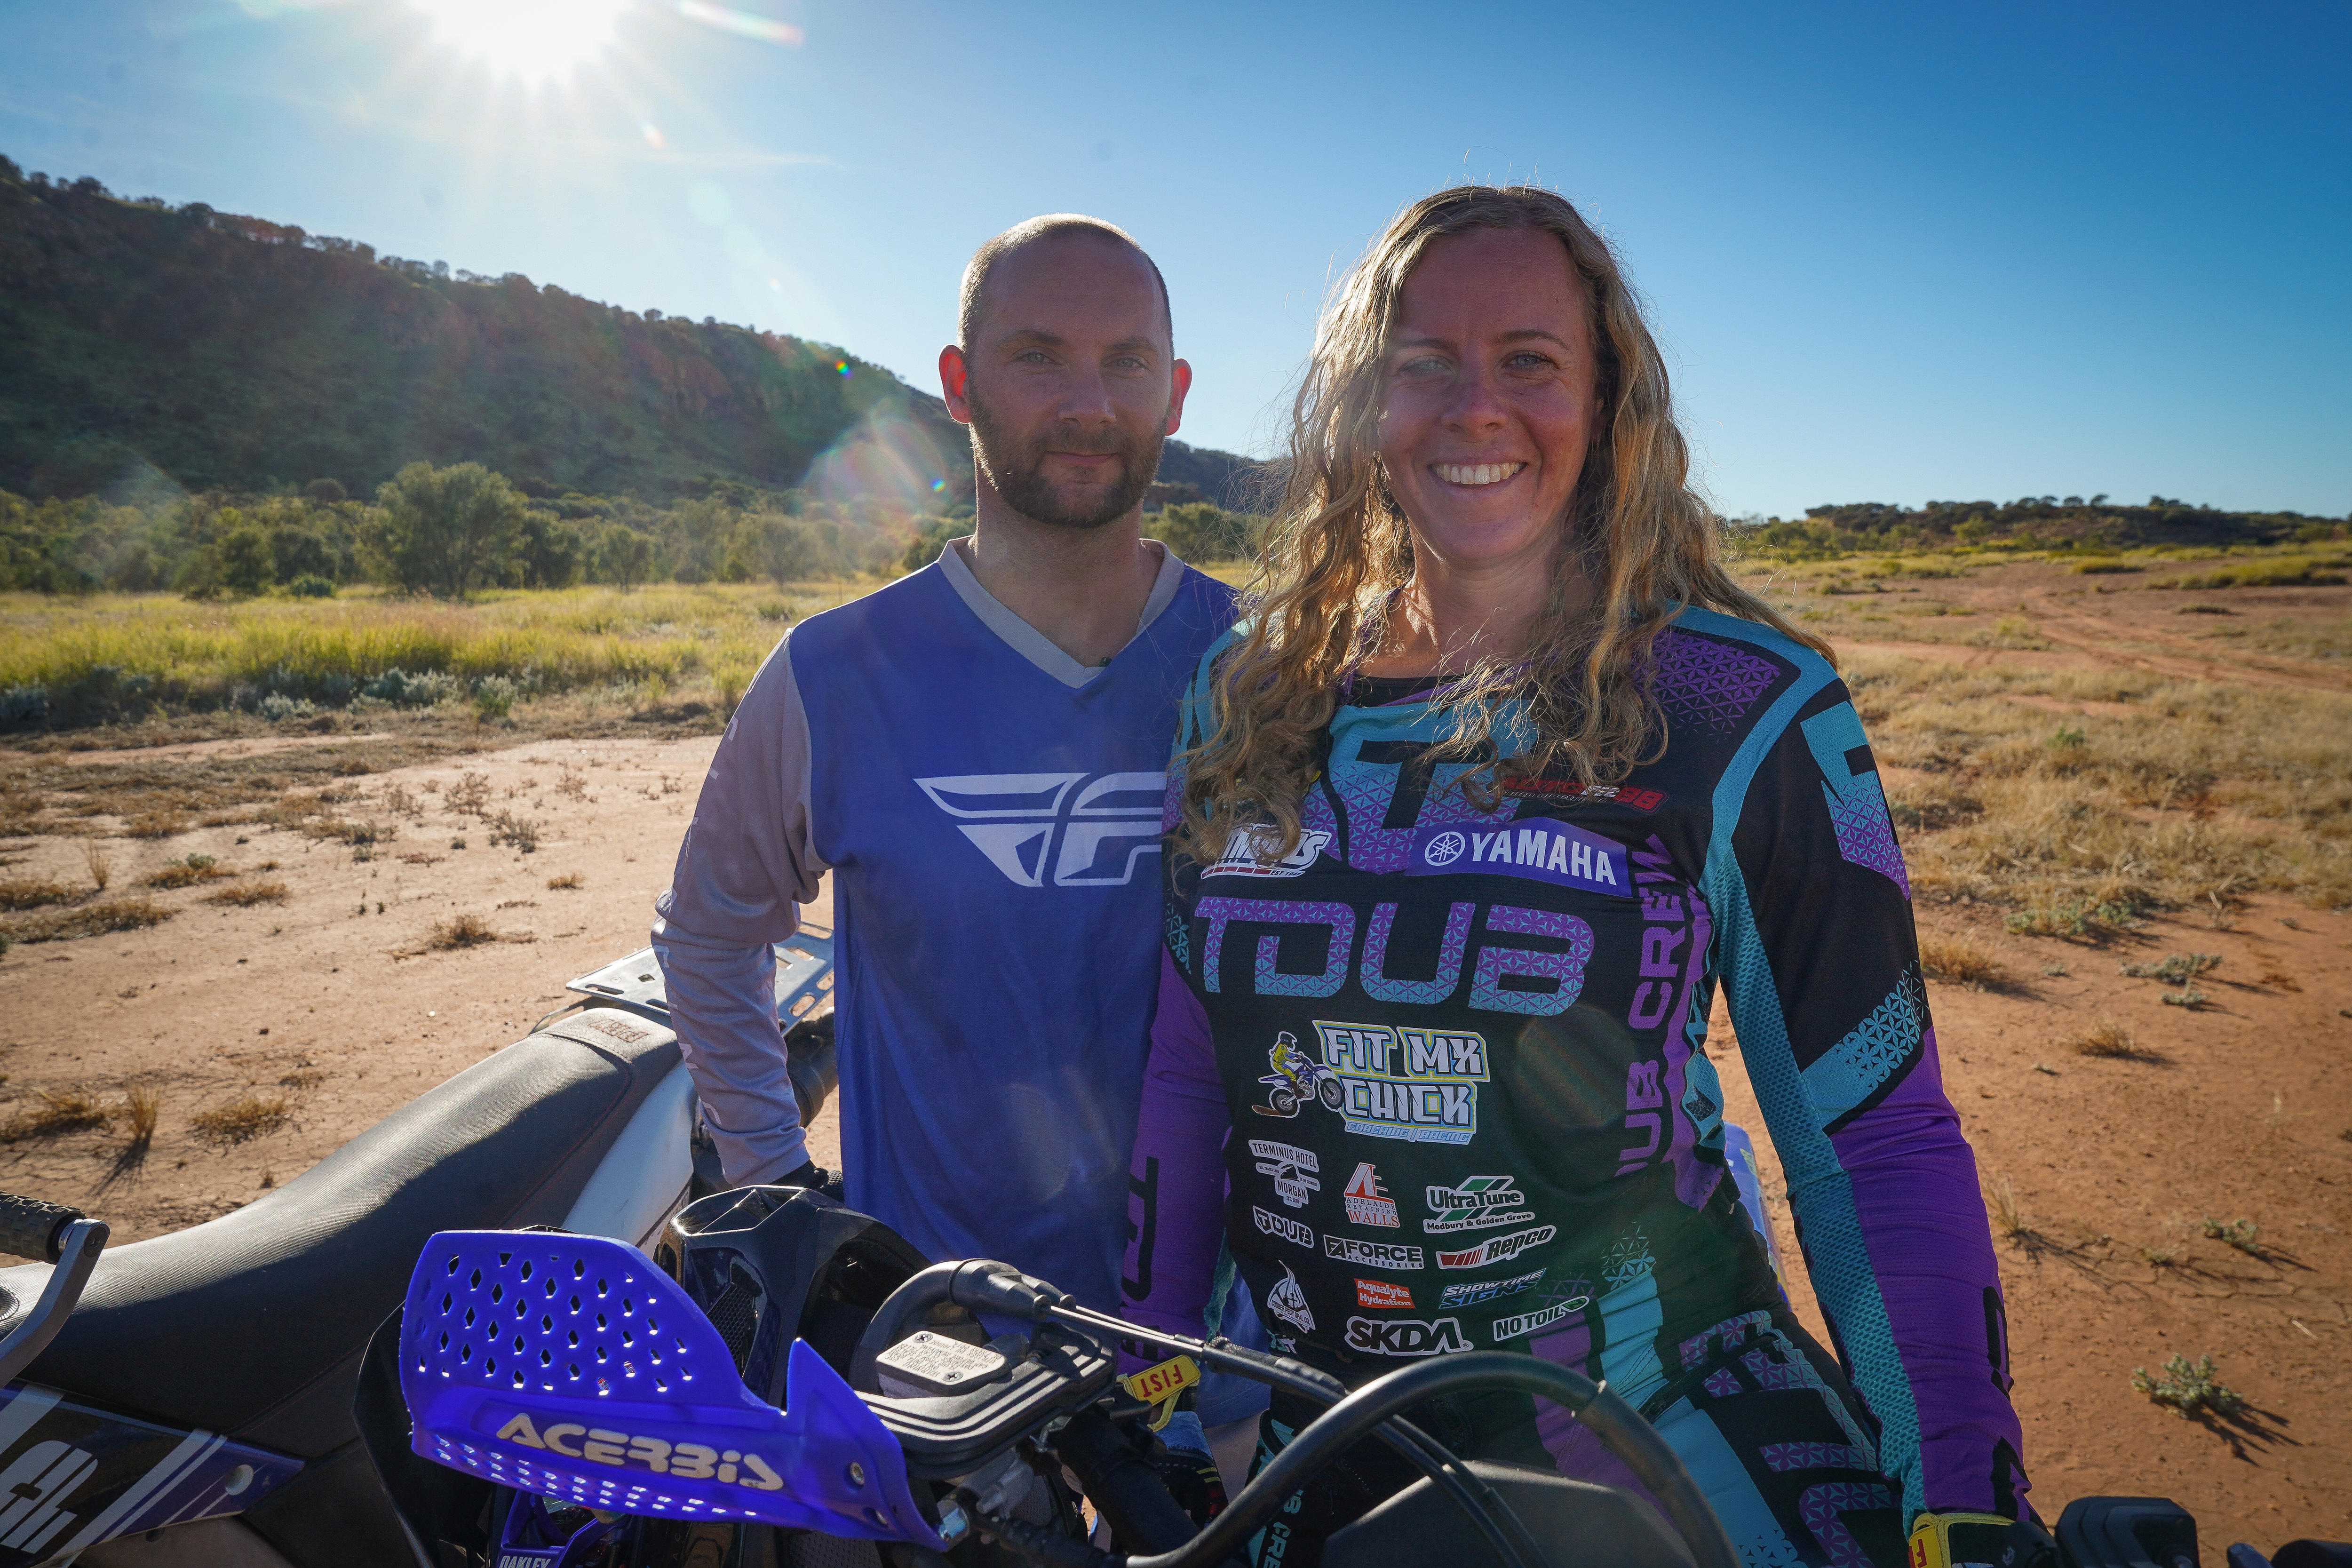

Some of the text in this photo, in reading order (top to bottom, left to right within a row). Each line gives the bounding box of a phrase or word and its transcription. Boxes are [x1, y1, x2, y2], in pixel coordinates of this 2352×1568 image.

[1471, 829, 1617, 886] YAMAHA
[1322, 1027, 1485, 1076] FIT MX
[1340, 1076, 1471, 1125] CHICK
[1347, 1121, 1471, 1143] COACHING RACING
[1252, 1143, 1317, 1168] TERMINUS HOTEL
[1278, 1180, 1306, 1200] MORGAN
[1346, 1197, 1395, 1210] ADELAIDE
[1347, 1203, 1397, 1216] RETAINING
[1348, 1210, 1400, 1227] WALLS
[1476, 1217, 1505, 1226] Golden
[1347, 1241, 1422, 1262] FORCE
[1486, 1228, 1553, 1261] Repco
[1348, 1255, 1423, 1268] ACCESSORIES
[1358, 1280, 1410, 1298] Aqualyte
[1439, 1282, 1538, 1309] SIGNS
[1444, 1270, 1544, 1296] SHOWTIME
[1359, 1293, 1412, 1306] Hydration
[1496, 1306, 1565, 1339] NO TOIL
[1348, 1319, 1462, 1353] SKDA
[1140, 1364, 1184, 1398] FIST
[496, 1412, 784, 1491] ACERBIS
